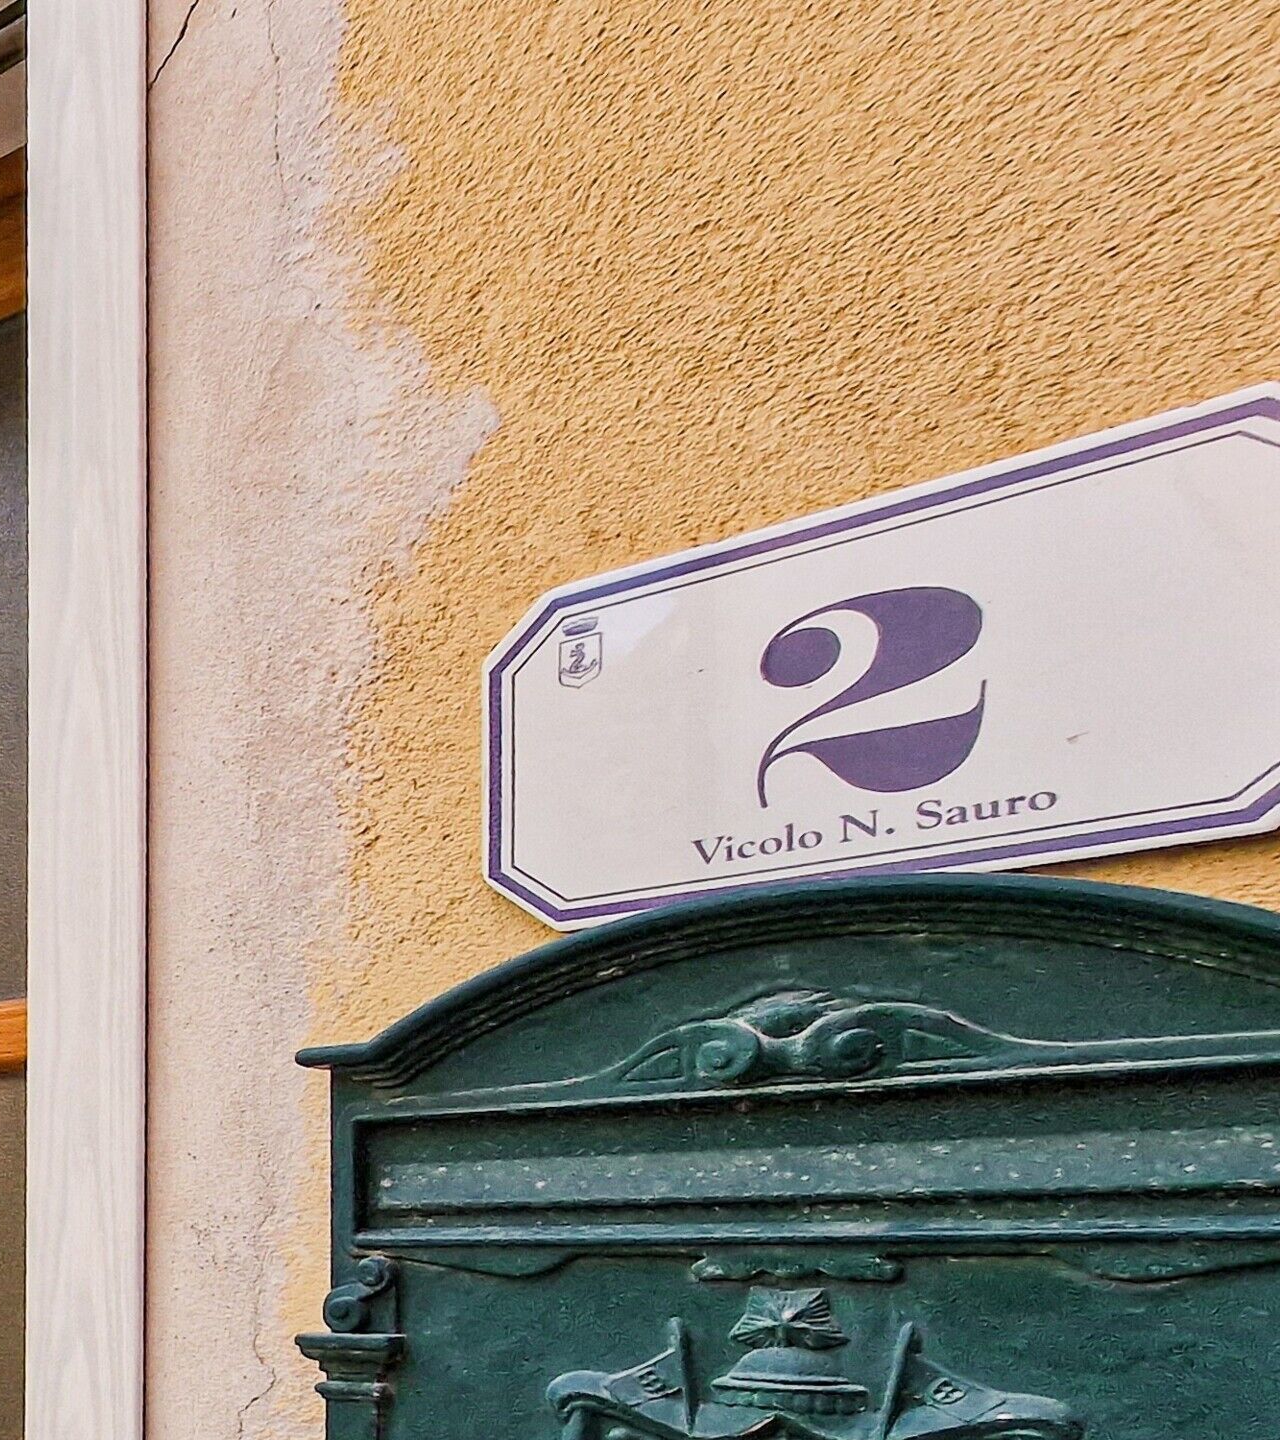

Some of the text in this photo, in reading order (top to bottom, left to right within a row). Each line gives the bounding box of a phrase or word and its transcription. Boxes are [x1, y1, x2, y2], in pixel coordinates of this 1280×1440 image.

[757, 586, 988, 809] 2
[690, 790, 1058, 865] Vicolo N. Sauro
